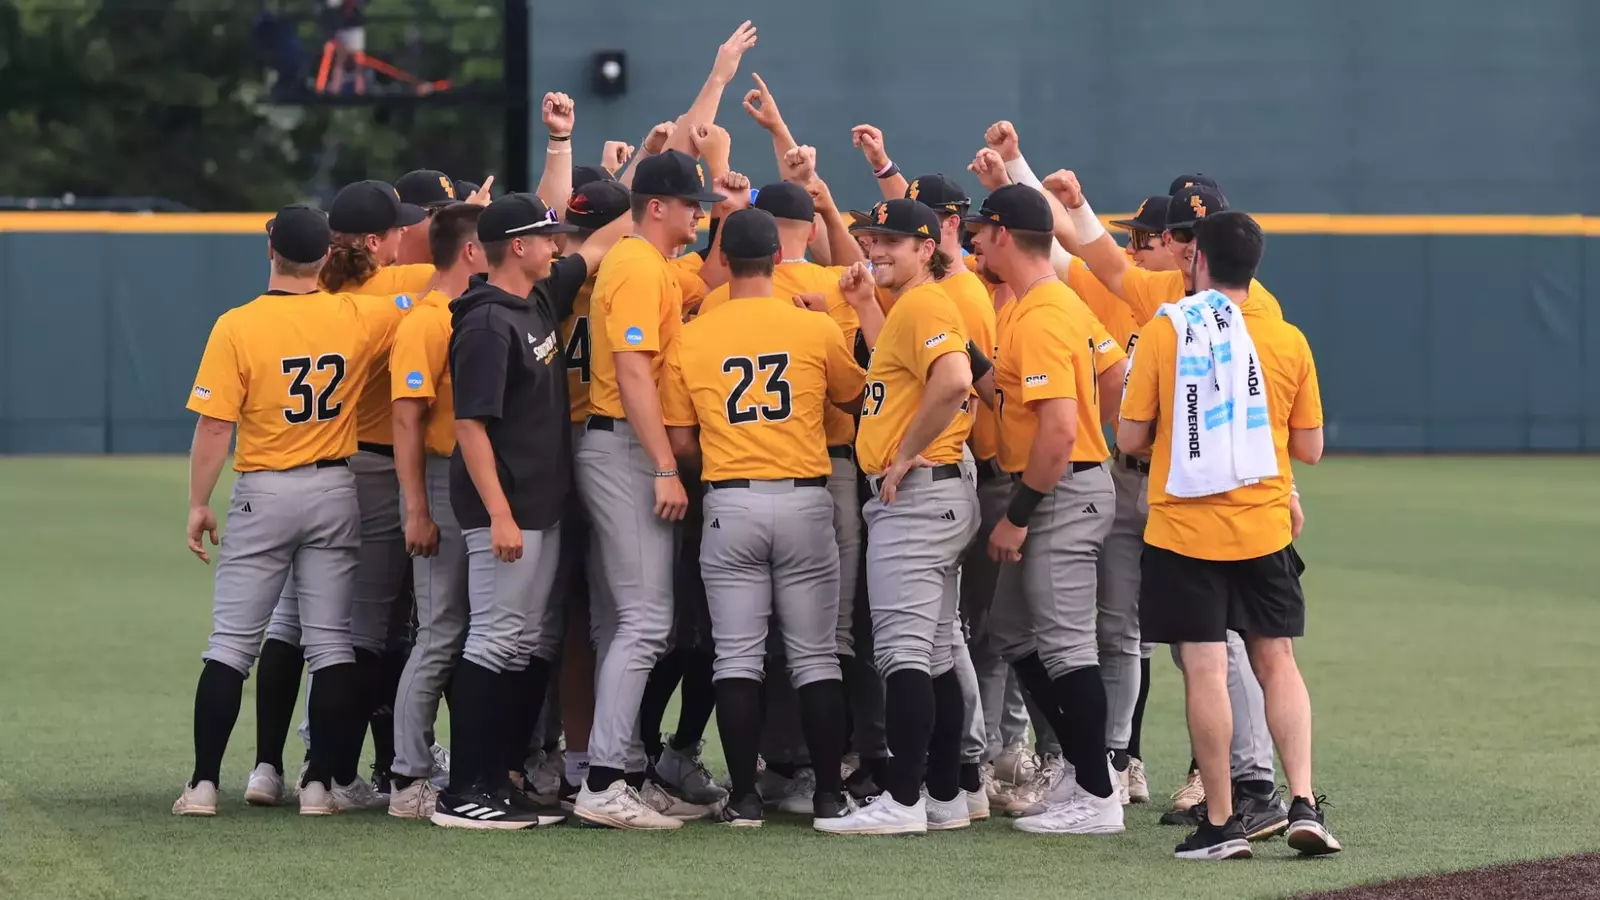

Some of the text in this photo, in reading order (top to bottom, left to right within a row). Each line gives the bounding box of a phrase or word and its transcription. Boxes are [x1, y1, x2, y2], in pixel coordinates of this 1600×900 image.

[281, 353, 346, 425] 32
[722, 352, 792, 425] 23
[862, 381, 887, 416] 29
[1185, 383, 1200, 460] POWERADE
